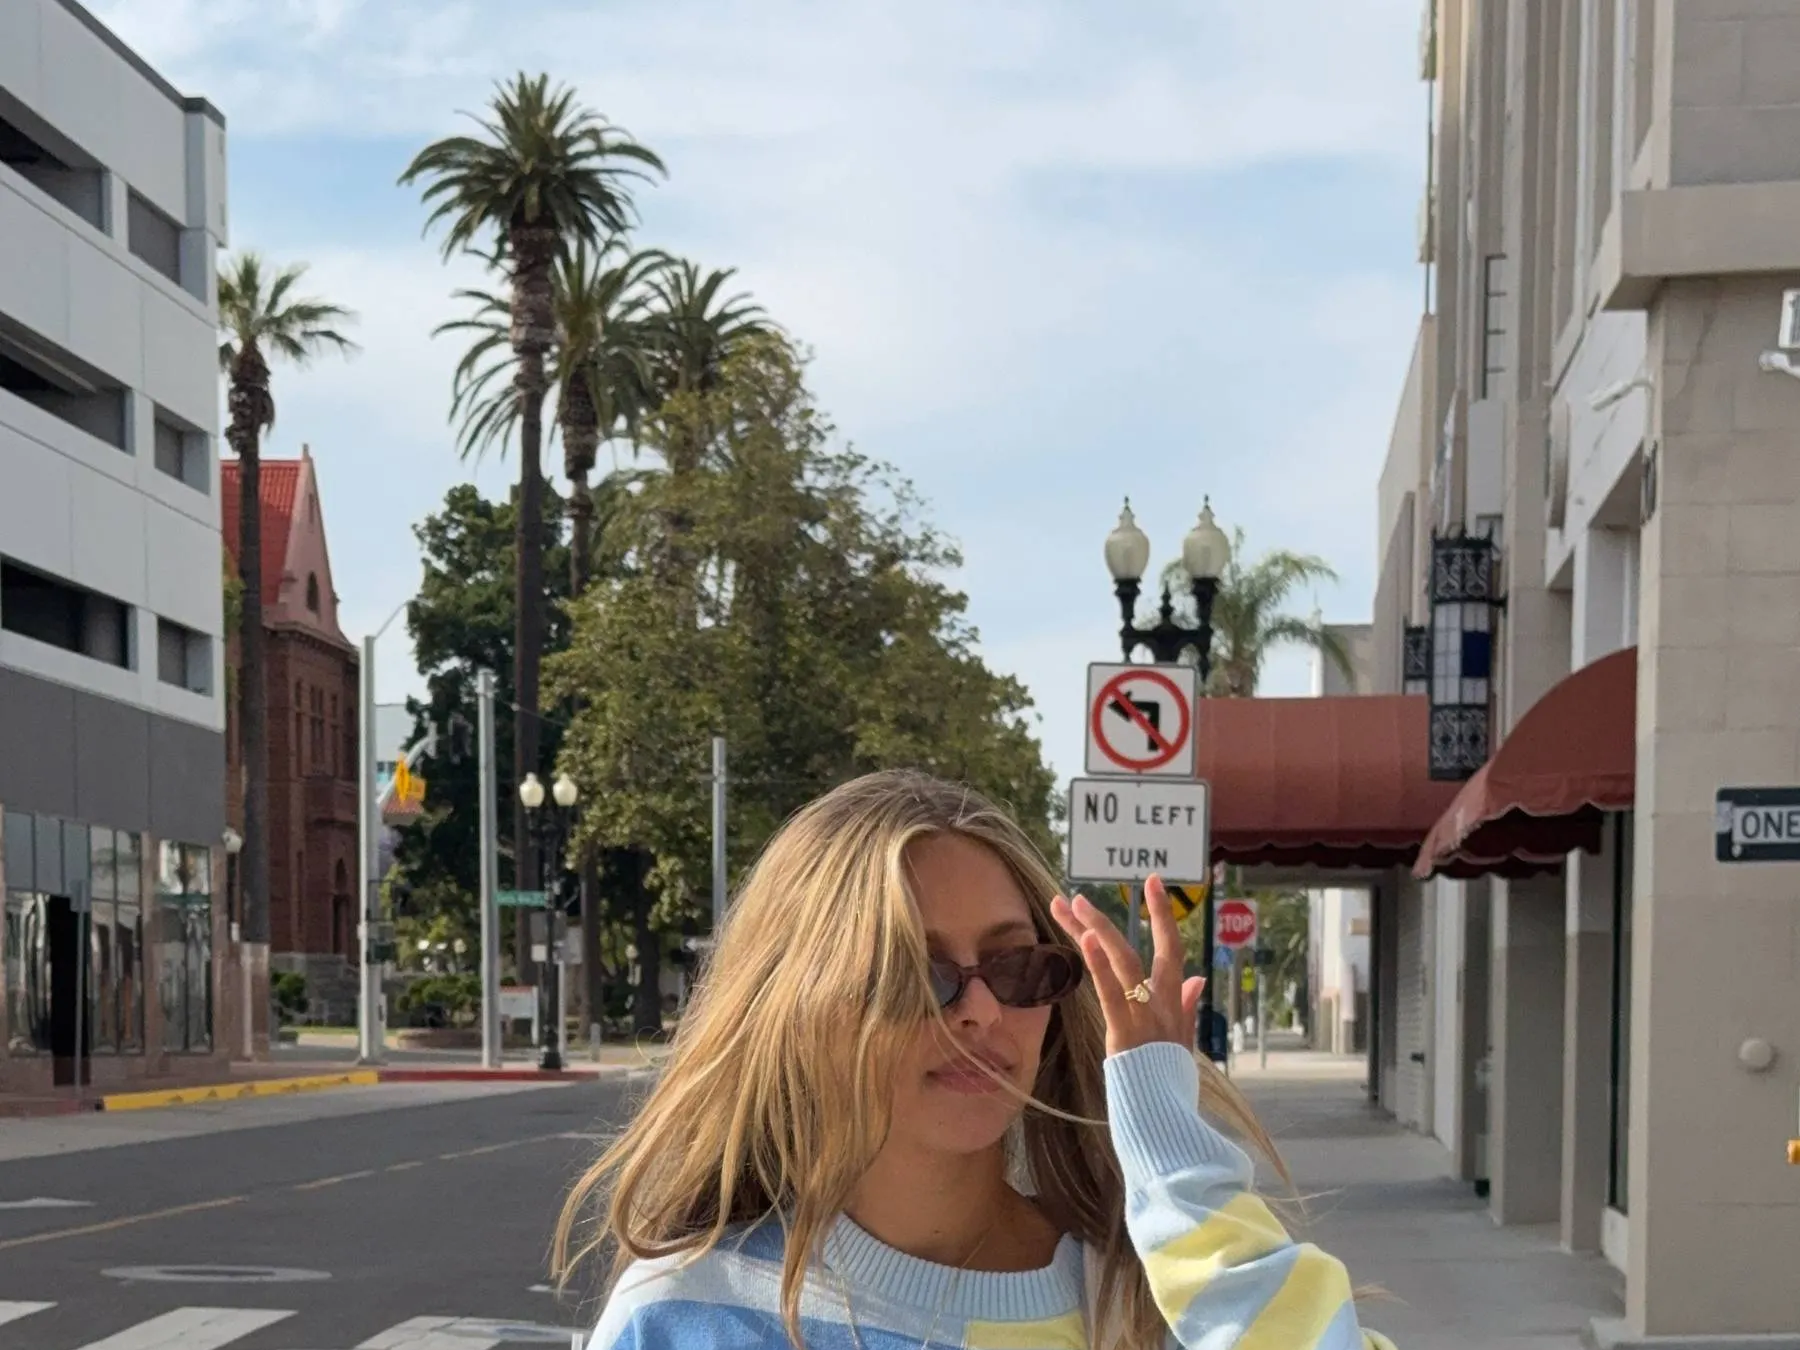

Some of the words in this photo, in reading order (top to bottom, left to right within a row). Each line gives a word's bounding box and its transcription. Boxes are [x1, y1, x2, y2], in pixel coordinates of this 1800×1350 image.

[1085, 792, 1118, 824] NO
[1135, 805, 1196, 826] LEFT
[1741, 811, 1800, 838] ONE
[1106, 847, 1168, 868] TURN
